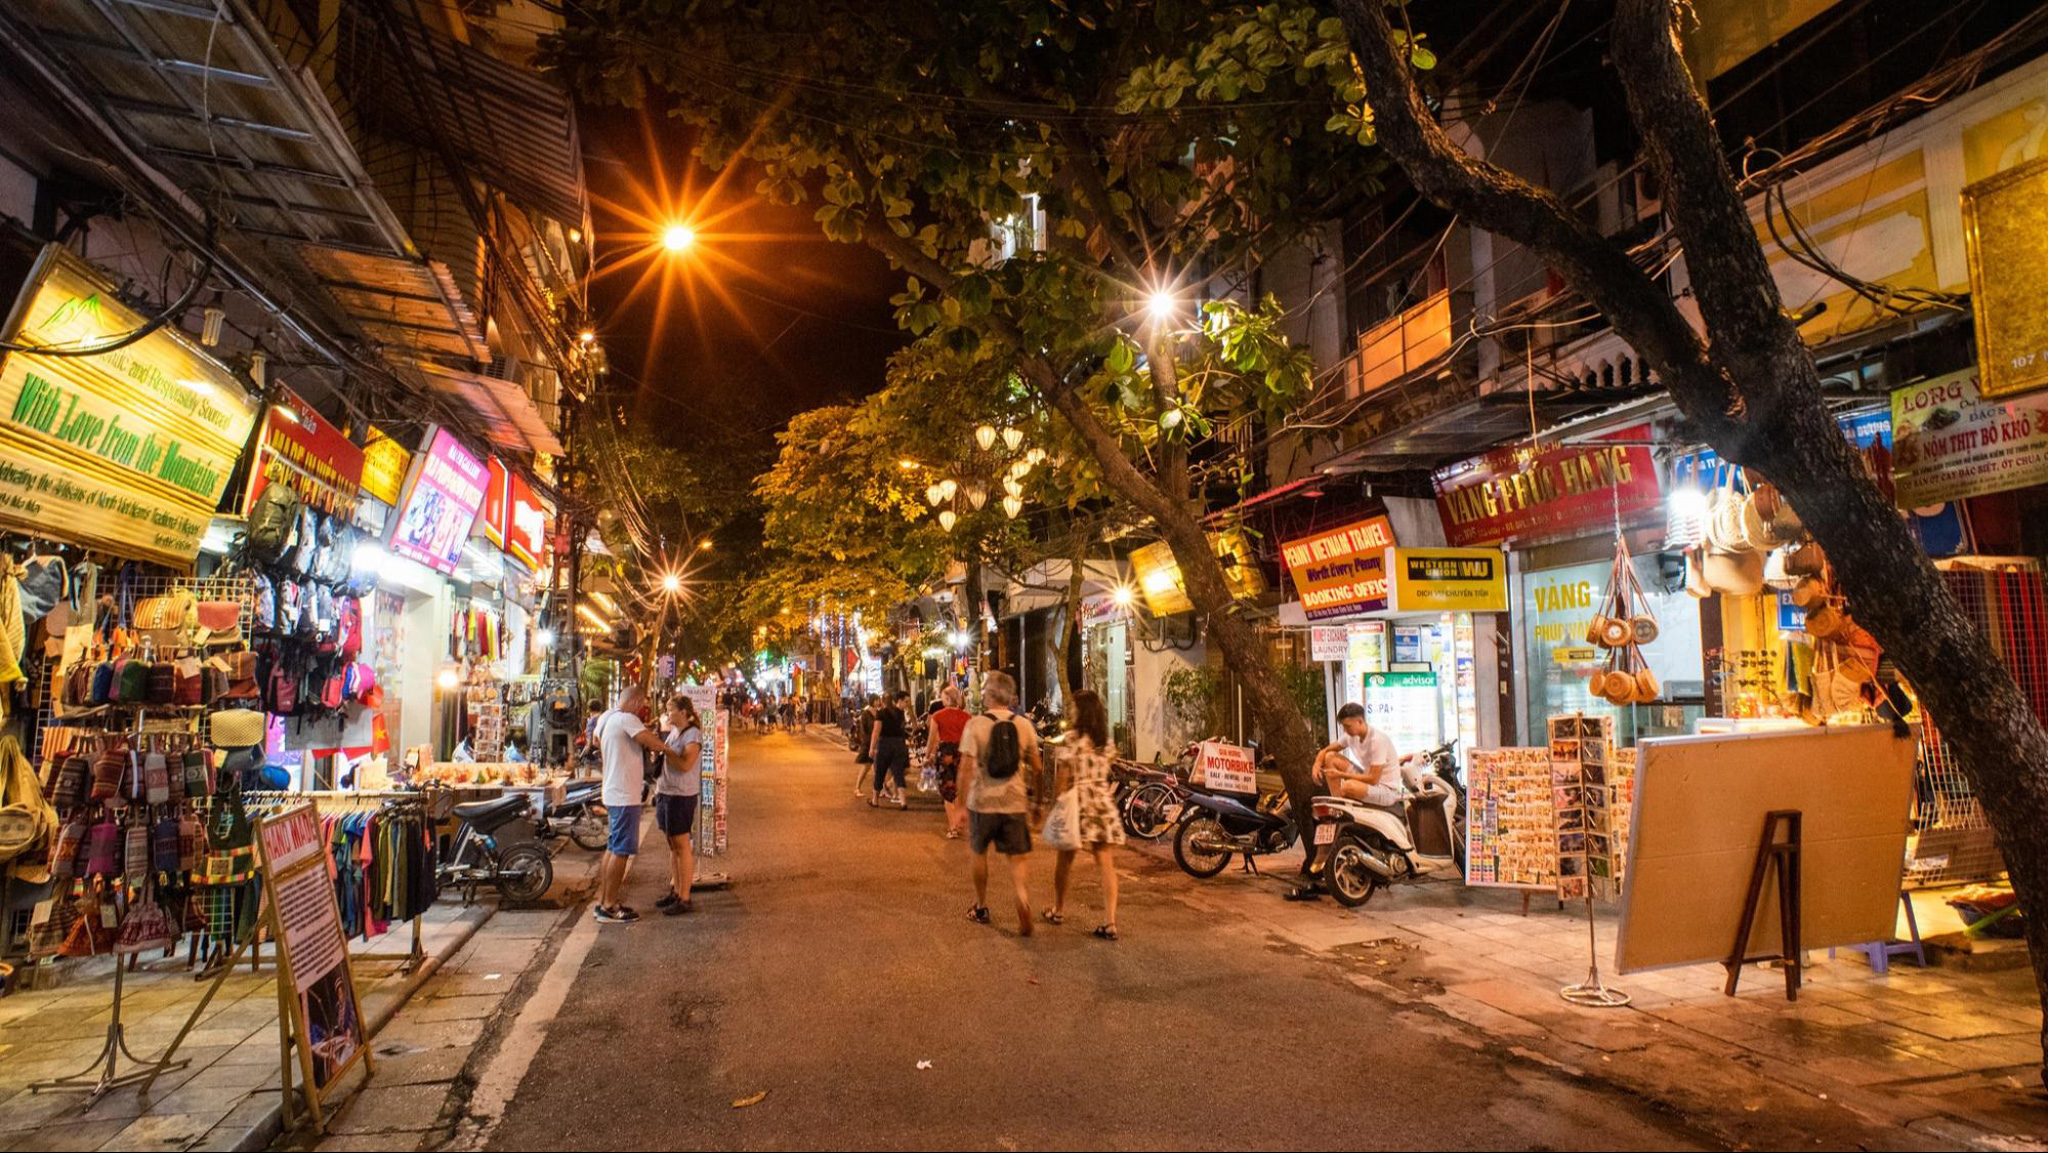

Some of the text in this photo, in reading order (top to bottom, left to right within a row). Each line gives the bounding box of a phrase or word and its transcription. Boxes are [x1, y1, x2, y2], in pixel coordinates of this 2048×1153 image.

[128, 360, 151, 383] and
[2011, 353, 2035, 369] 107
[1903, 380, 1963, 415] LONG
[11, 371, 63, 434] With
[55, 393, 105, 451] Love
[97, 414, 141, 466] from
[135, 431, 163, 474] the
[158, 440, 220, 498] Mountains
[1444, 483, 1498, 525] VÀNG
[1282, 522, 1394, 569] PENNY VIETNAM TRAVEL
[1328, 562, 1354, 578] Every
[1353, 556, 1382, 573] Penny
[1409, 560, 1457, 569] WESTERN
[1425, 561, 1489, 577] UNION WU
[1303, 577, 1388, 607] BOOKING OFFIC
[1534, 577, 1591, 613] VÀNG
[1313, 645, 1348, 654] LAUNDRY
[1367, 703, 1390, 714] SPA
[1207, 756, 1254, 774] MOTORBIKE
[262, 811, 317, 861] HAND MADE
